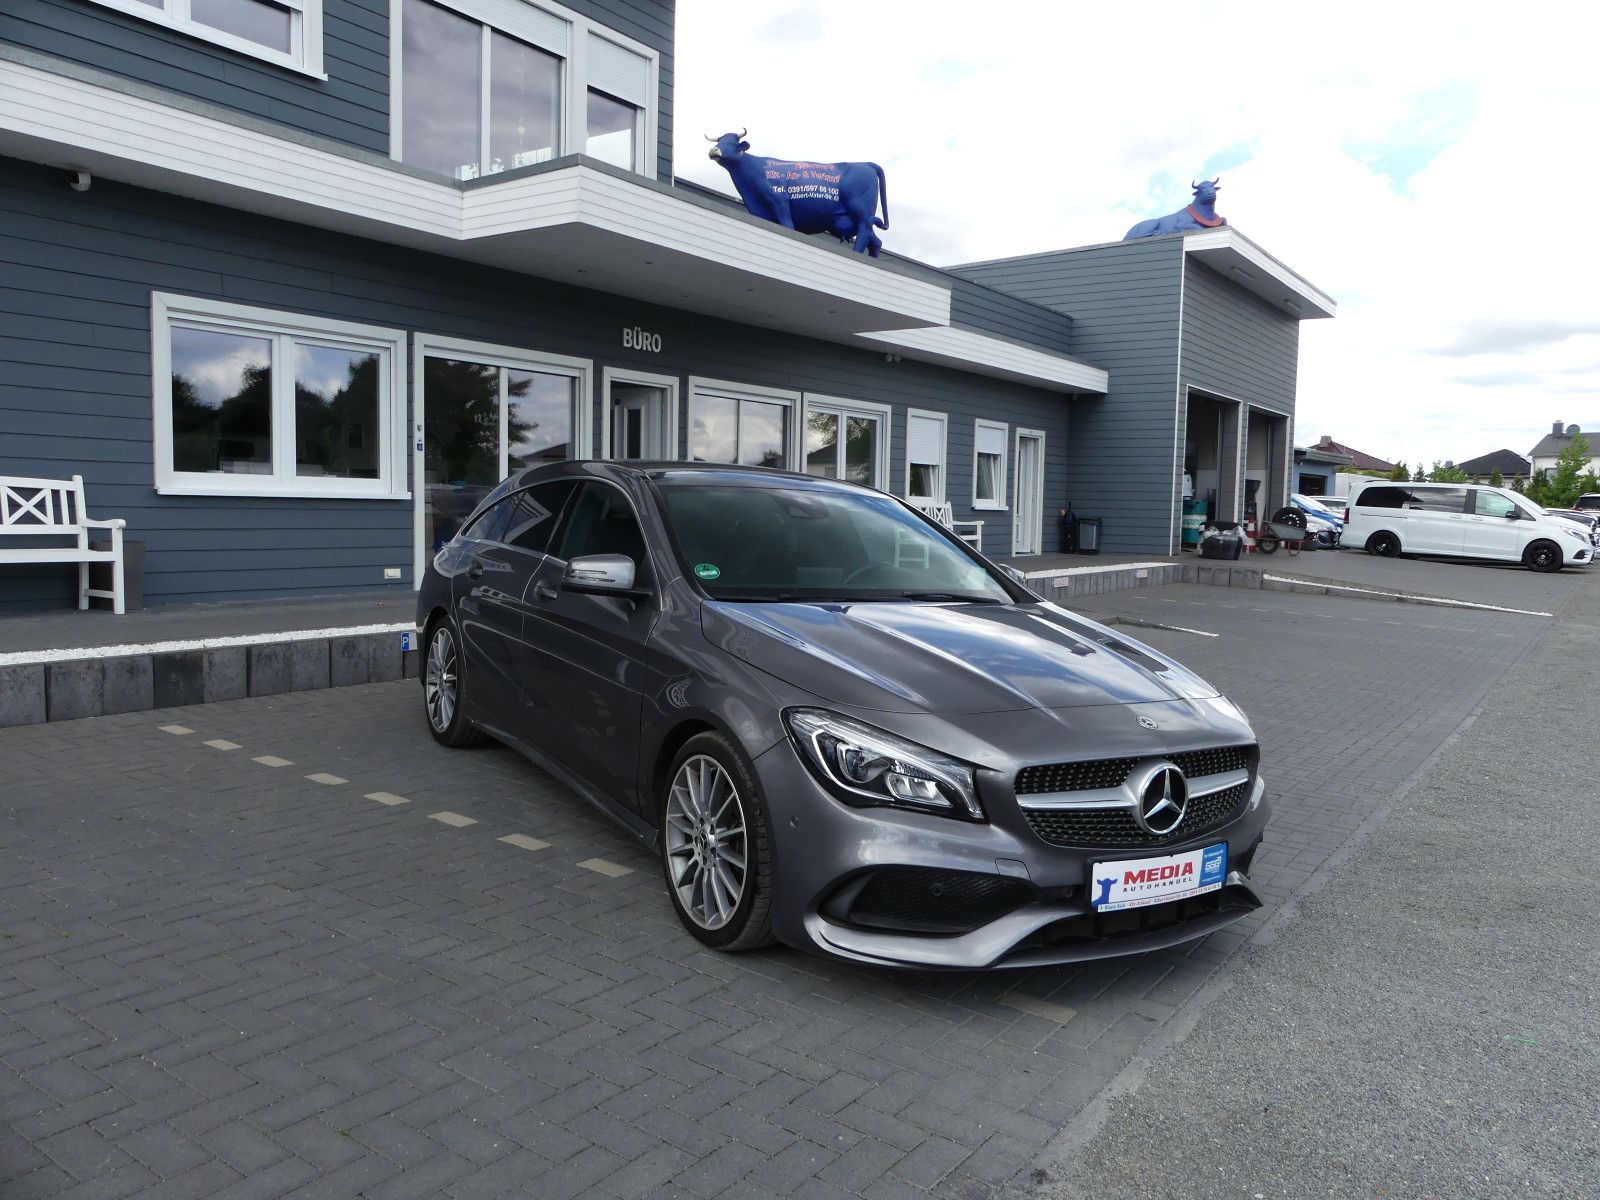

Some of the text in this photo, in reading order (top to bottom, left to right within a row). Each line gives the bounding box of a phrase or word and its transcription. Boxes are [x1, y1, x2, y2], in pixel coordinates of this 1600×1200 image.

[623, 326, 662, 353] BÜRO
[402, 636, 409, 648] P
[1124, 862, 1193, 885] MEDIA
[1122, 877, 1193, 892] AUTOHANDEL
